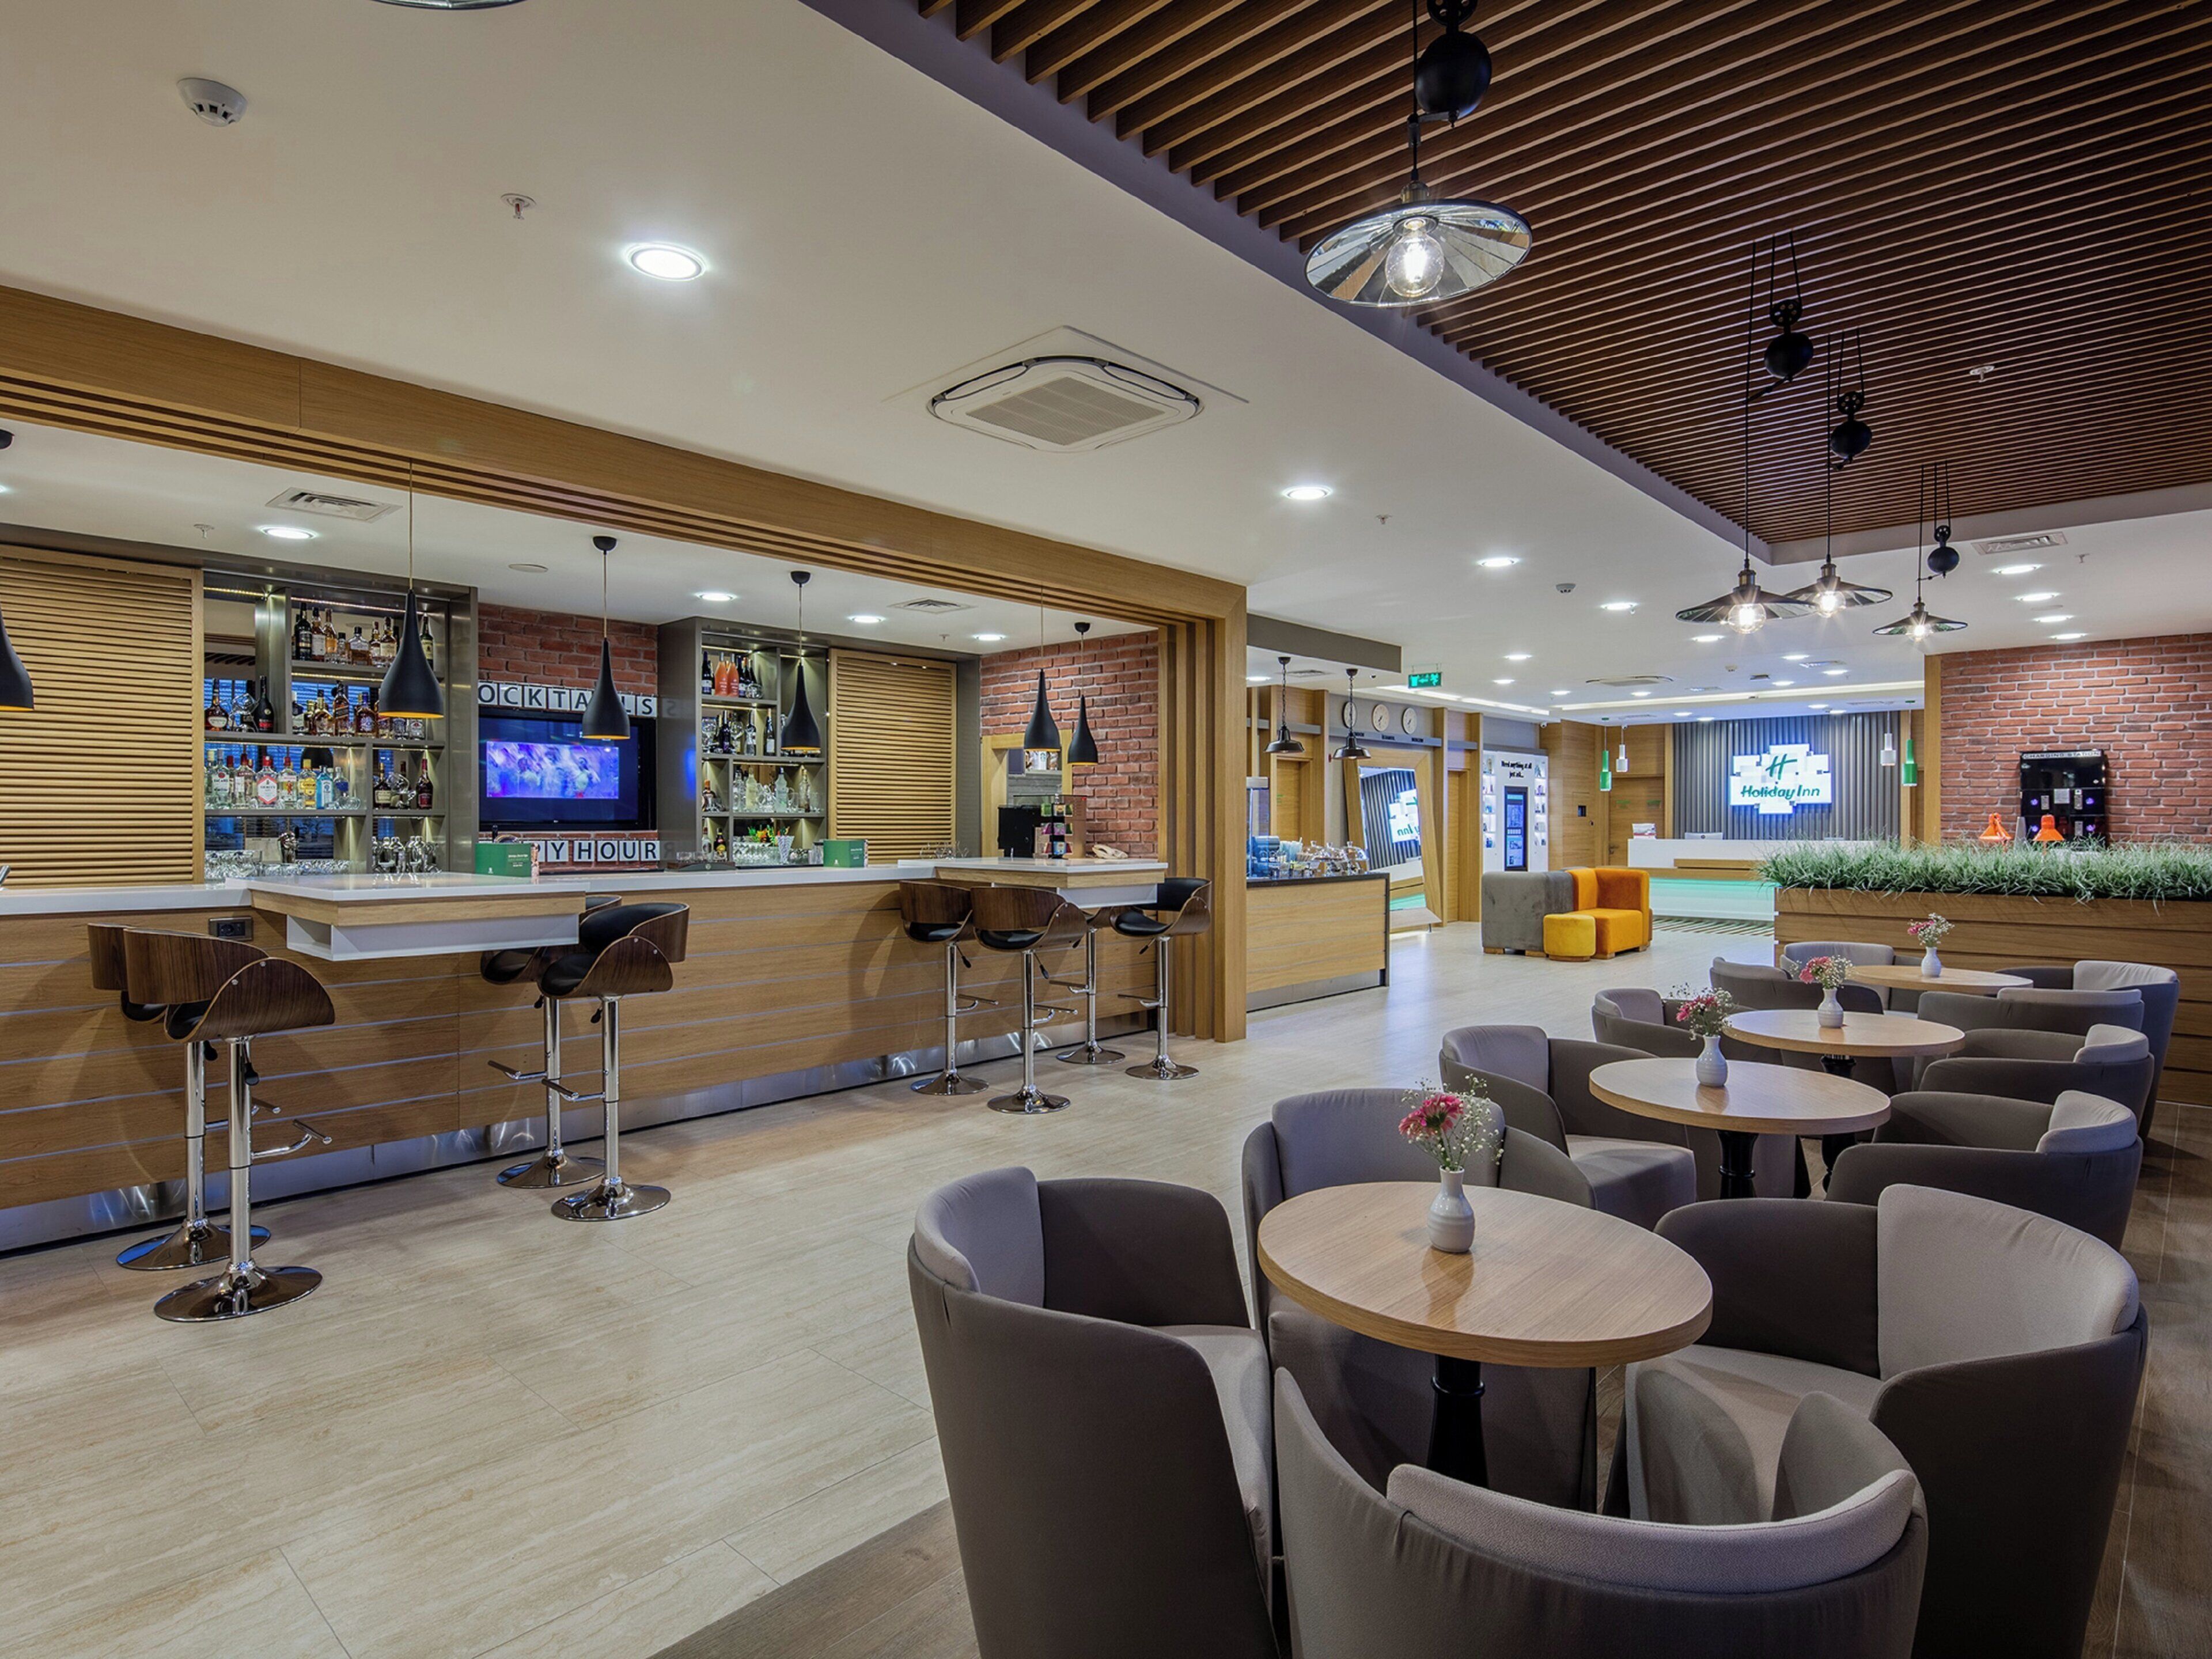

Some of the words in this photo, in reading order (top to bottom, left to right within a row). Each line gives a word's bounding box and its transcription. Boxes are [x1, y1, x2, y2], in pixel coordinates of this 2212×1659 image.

[478, 684, 653, 715] OCKTALS
[1740, 785, 1795, 800] Holiday
[1797, 785, 1820, 797] Inn
[578, 841, 657, 860] HOUR
